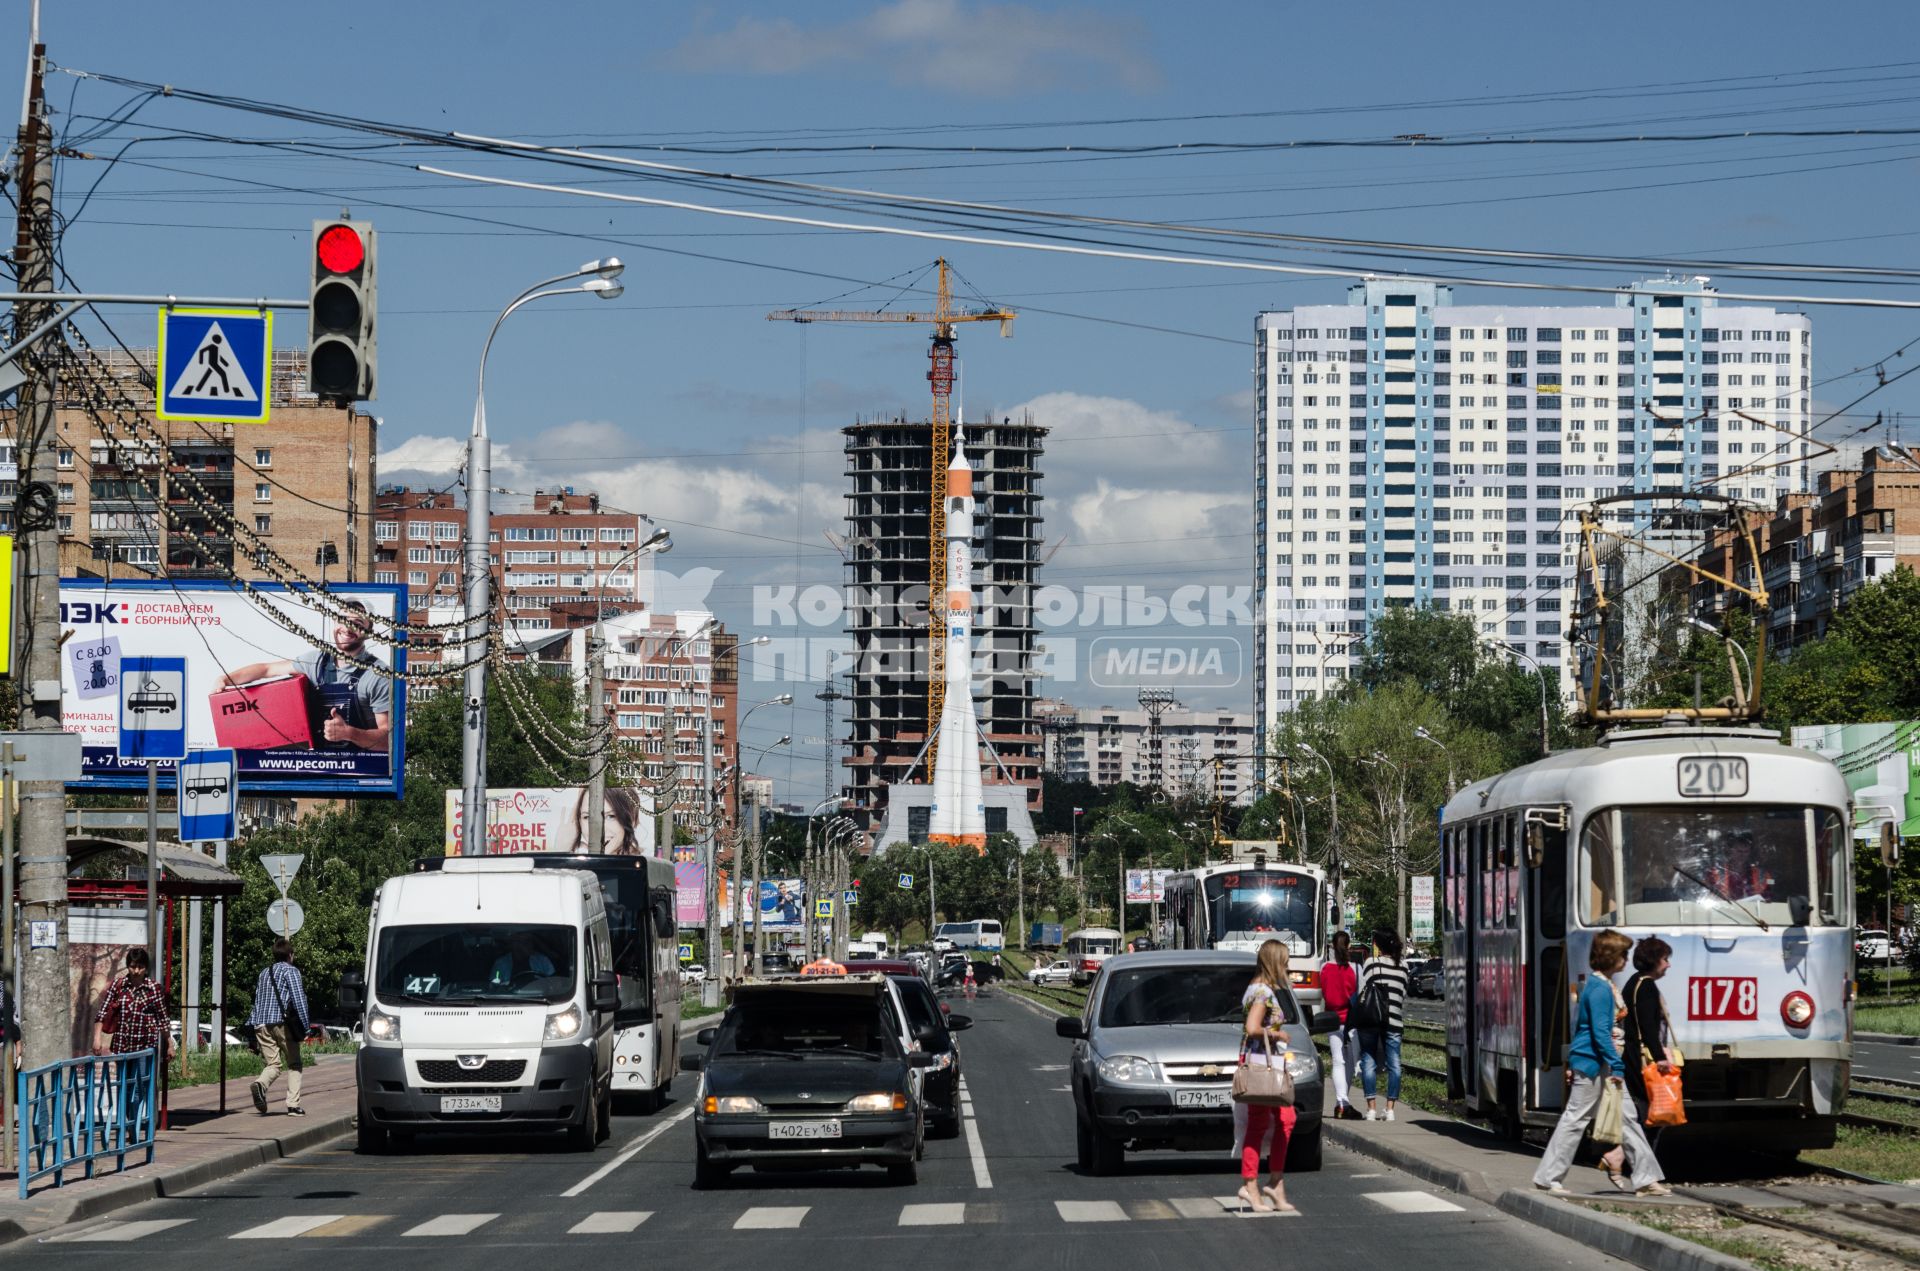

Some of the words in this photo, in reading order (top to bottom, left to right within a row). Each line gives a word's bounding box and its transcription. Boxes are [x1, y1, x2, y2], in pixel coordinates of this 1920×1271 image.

[135, 603, 214, 614] ДОСТАВЛЯЕМ
[135, 614, 191, 625] СБОРНЫЙ
[195, 616, 221, 626] ГРУЗ
[87, 645, 112, 659] 8.00
[222, 700, 260, 716] ПЭК
[97, 755, 113, 766] +7
[259, 759, 355, 770] www.pecom.ru
[453, 823, 547, 839] СХОВЫЕ
[1224, 875, 1240, 888] 22
[406, 977, 438, 993] 47
[1690, 979, 1756, 1016] 1178
[1180, 1091, 1225, 1104] Р791МЕ
[773, 1125, 818, 1137] Т402ЕУ
[820, 1123, 838, 1133] 163
